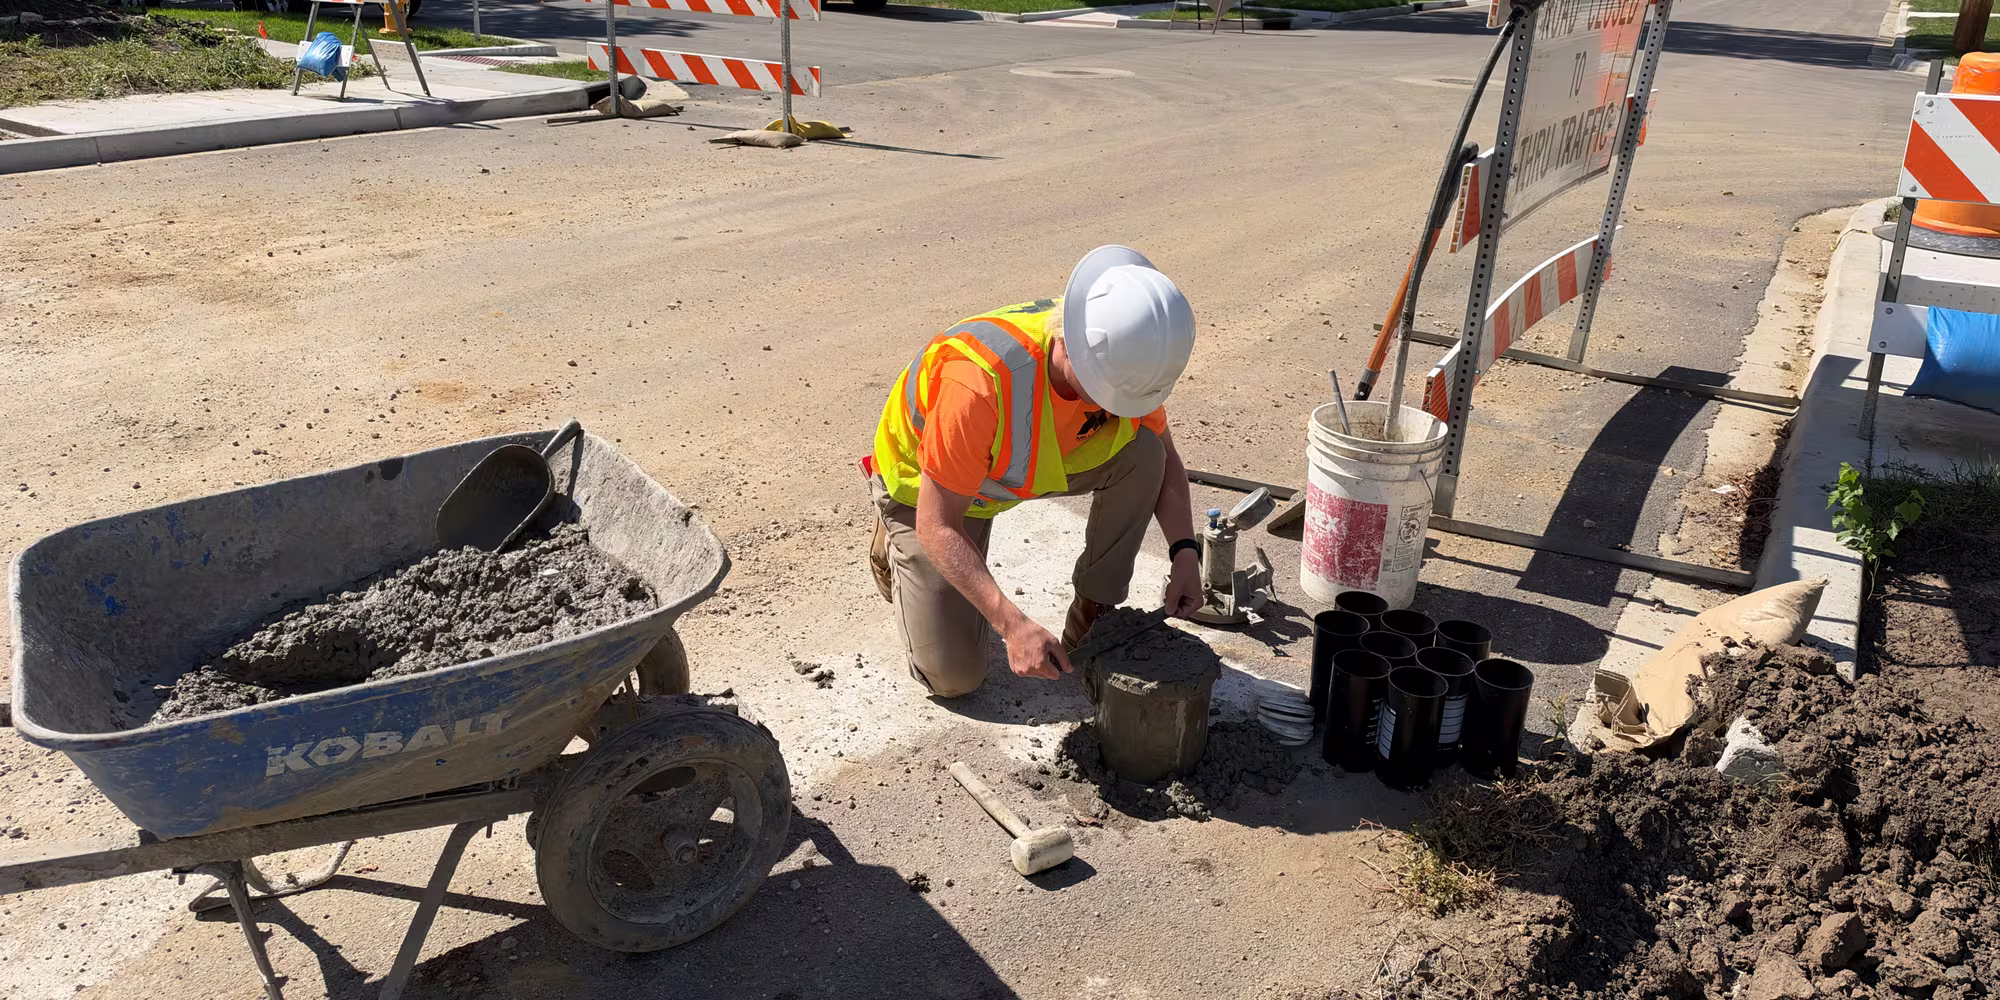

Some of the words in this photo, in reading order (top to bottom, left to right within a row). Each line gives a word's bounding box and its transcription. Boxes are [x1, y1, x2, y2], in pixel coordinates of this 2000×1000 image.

[1569, 51, 1588, 98] TO
[1515, 122, 1557, 195] THRU
[1555, 101, 1615, 171] TRAFFIC
[265, 710, 513, 777] KOBALT
